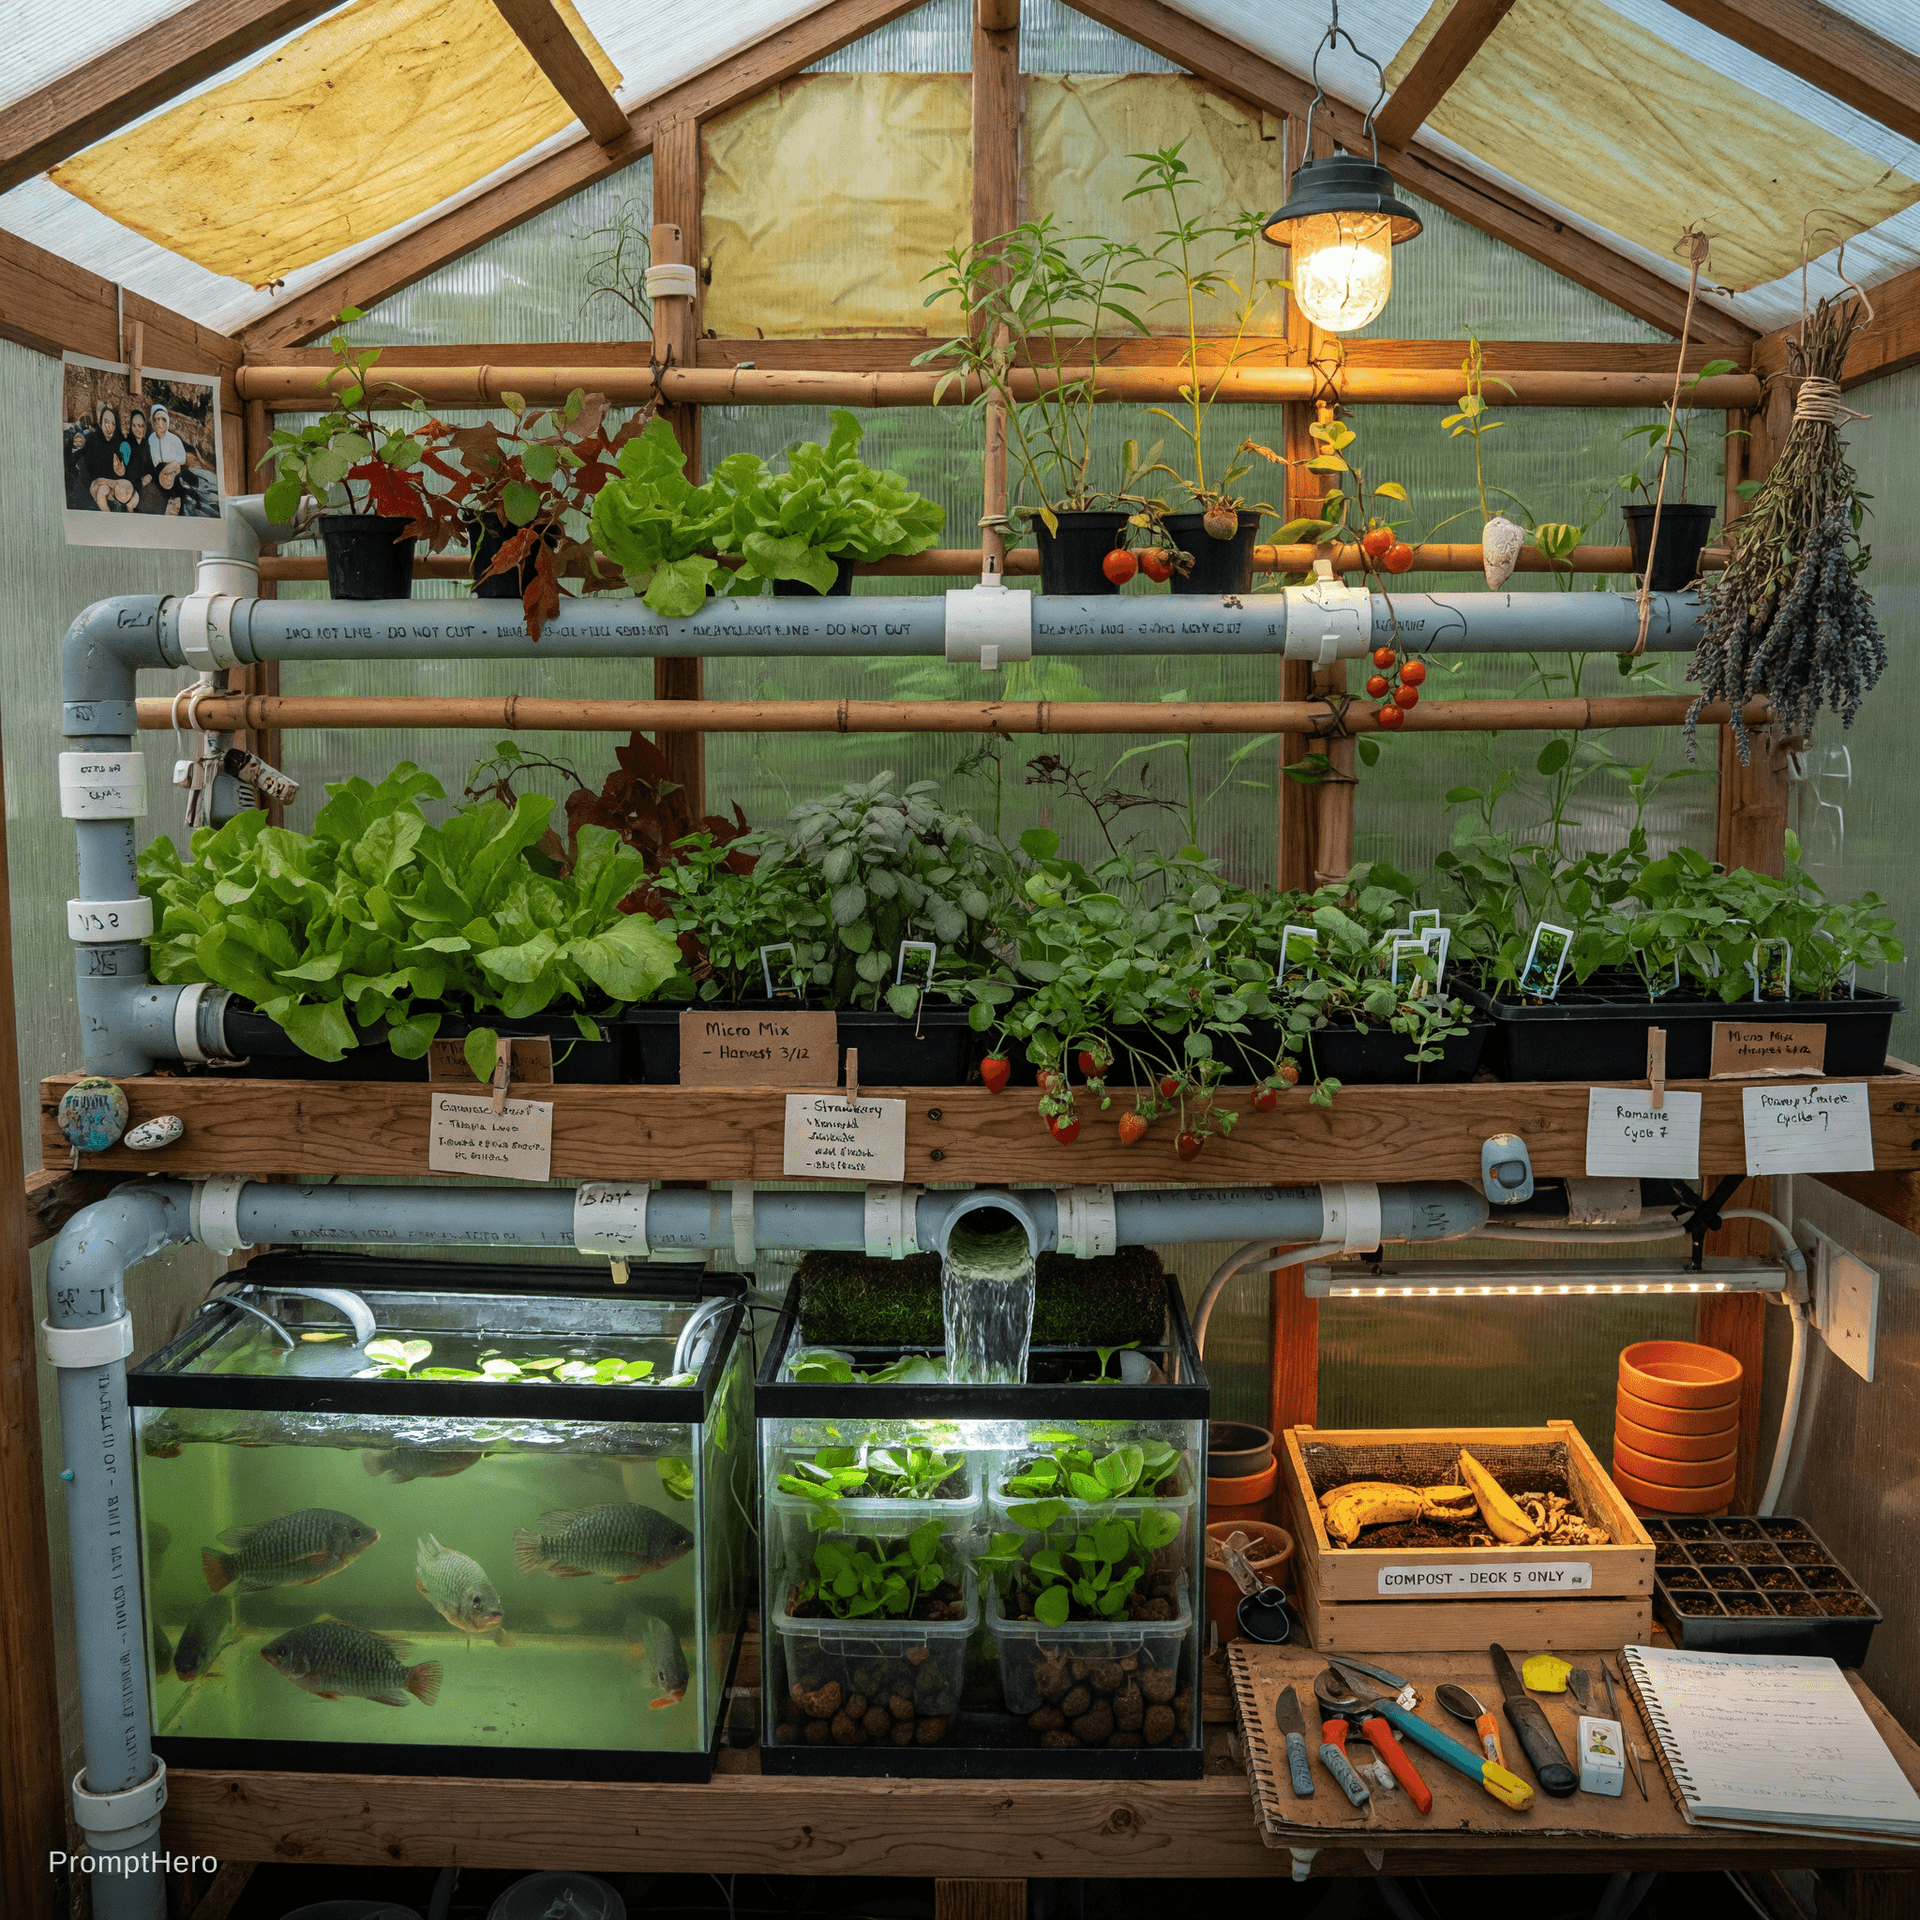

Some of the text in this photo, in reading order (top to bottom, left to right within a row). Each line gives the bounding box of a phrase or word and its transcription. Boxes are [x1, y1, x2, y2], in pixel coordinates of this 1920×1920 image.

[388, 626, 407, 638] DO
[826, 624, 846, 635] DO
[706, 1022, 790, 1036] Micro Mix
[720, 1045, 772, 1059] Harvest
[779, 1047, 810, 1062] 3/12
[1384, 1573, 1453, 1585] COMPOST
[1513, 1571, 1521, 1583] 5
[1528, 1571, 1565, 1582] ONLY
